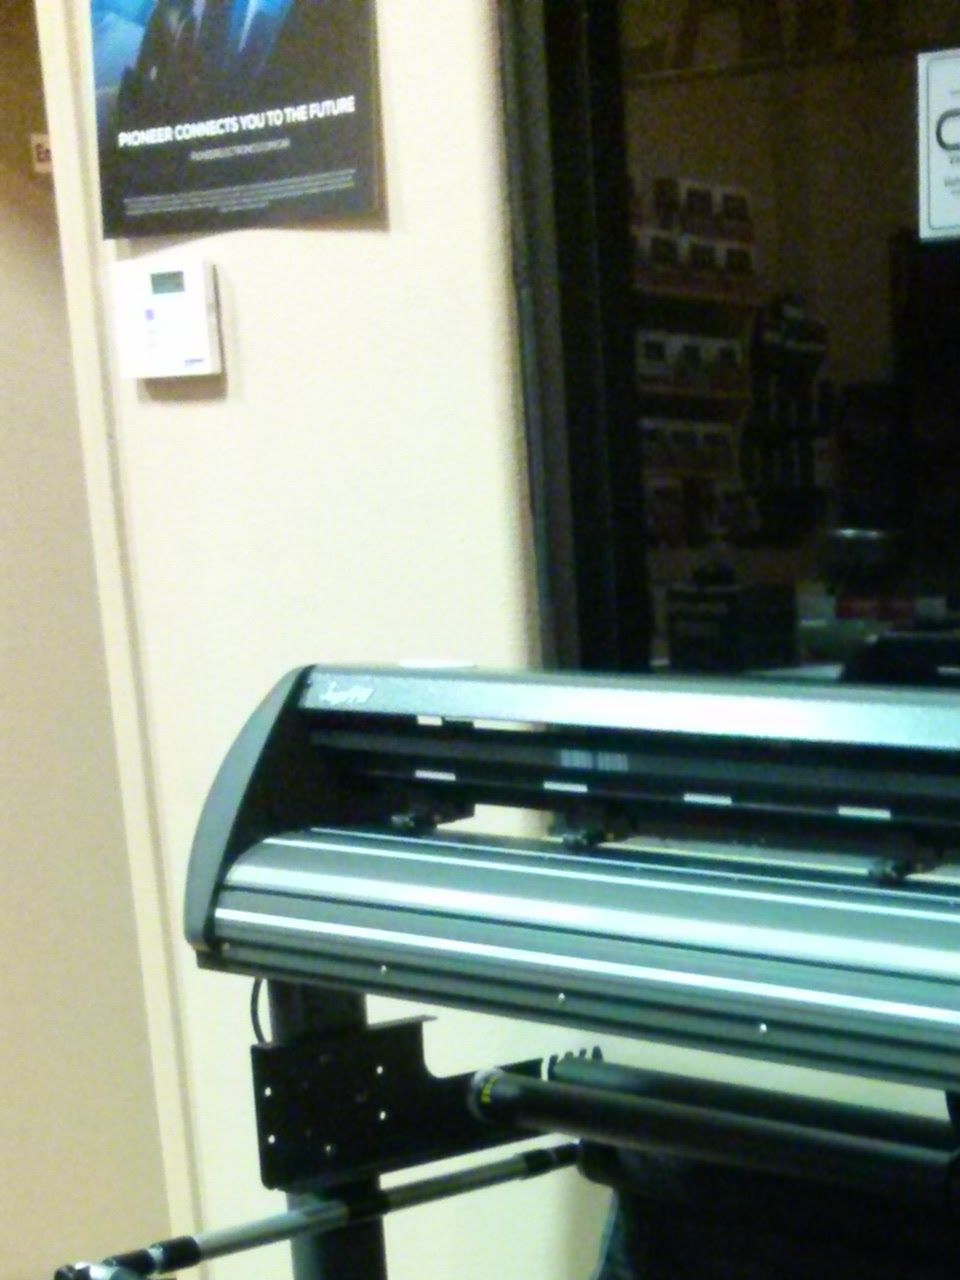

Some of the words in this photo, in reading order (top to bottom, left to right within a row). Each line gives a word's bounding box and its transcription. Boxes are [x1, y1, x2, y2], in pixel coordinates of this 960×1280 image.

[118, 126, 173, 148] PIONEER
[175, 114, 239, 141] CONNECTS
[240, 112, 265, 130] YOU
[266, 109, 283, 126] TO
[283, 103, 308, 123] THE
[309, 94, 356, 119] FUTURE
